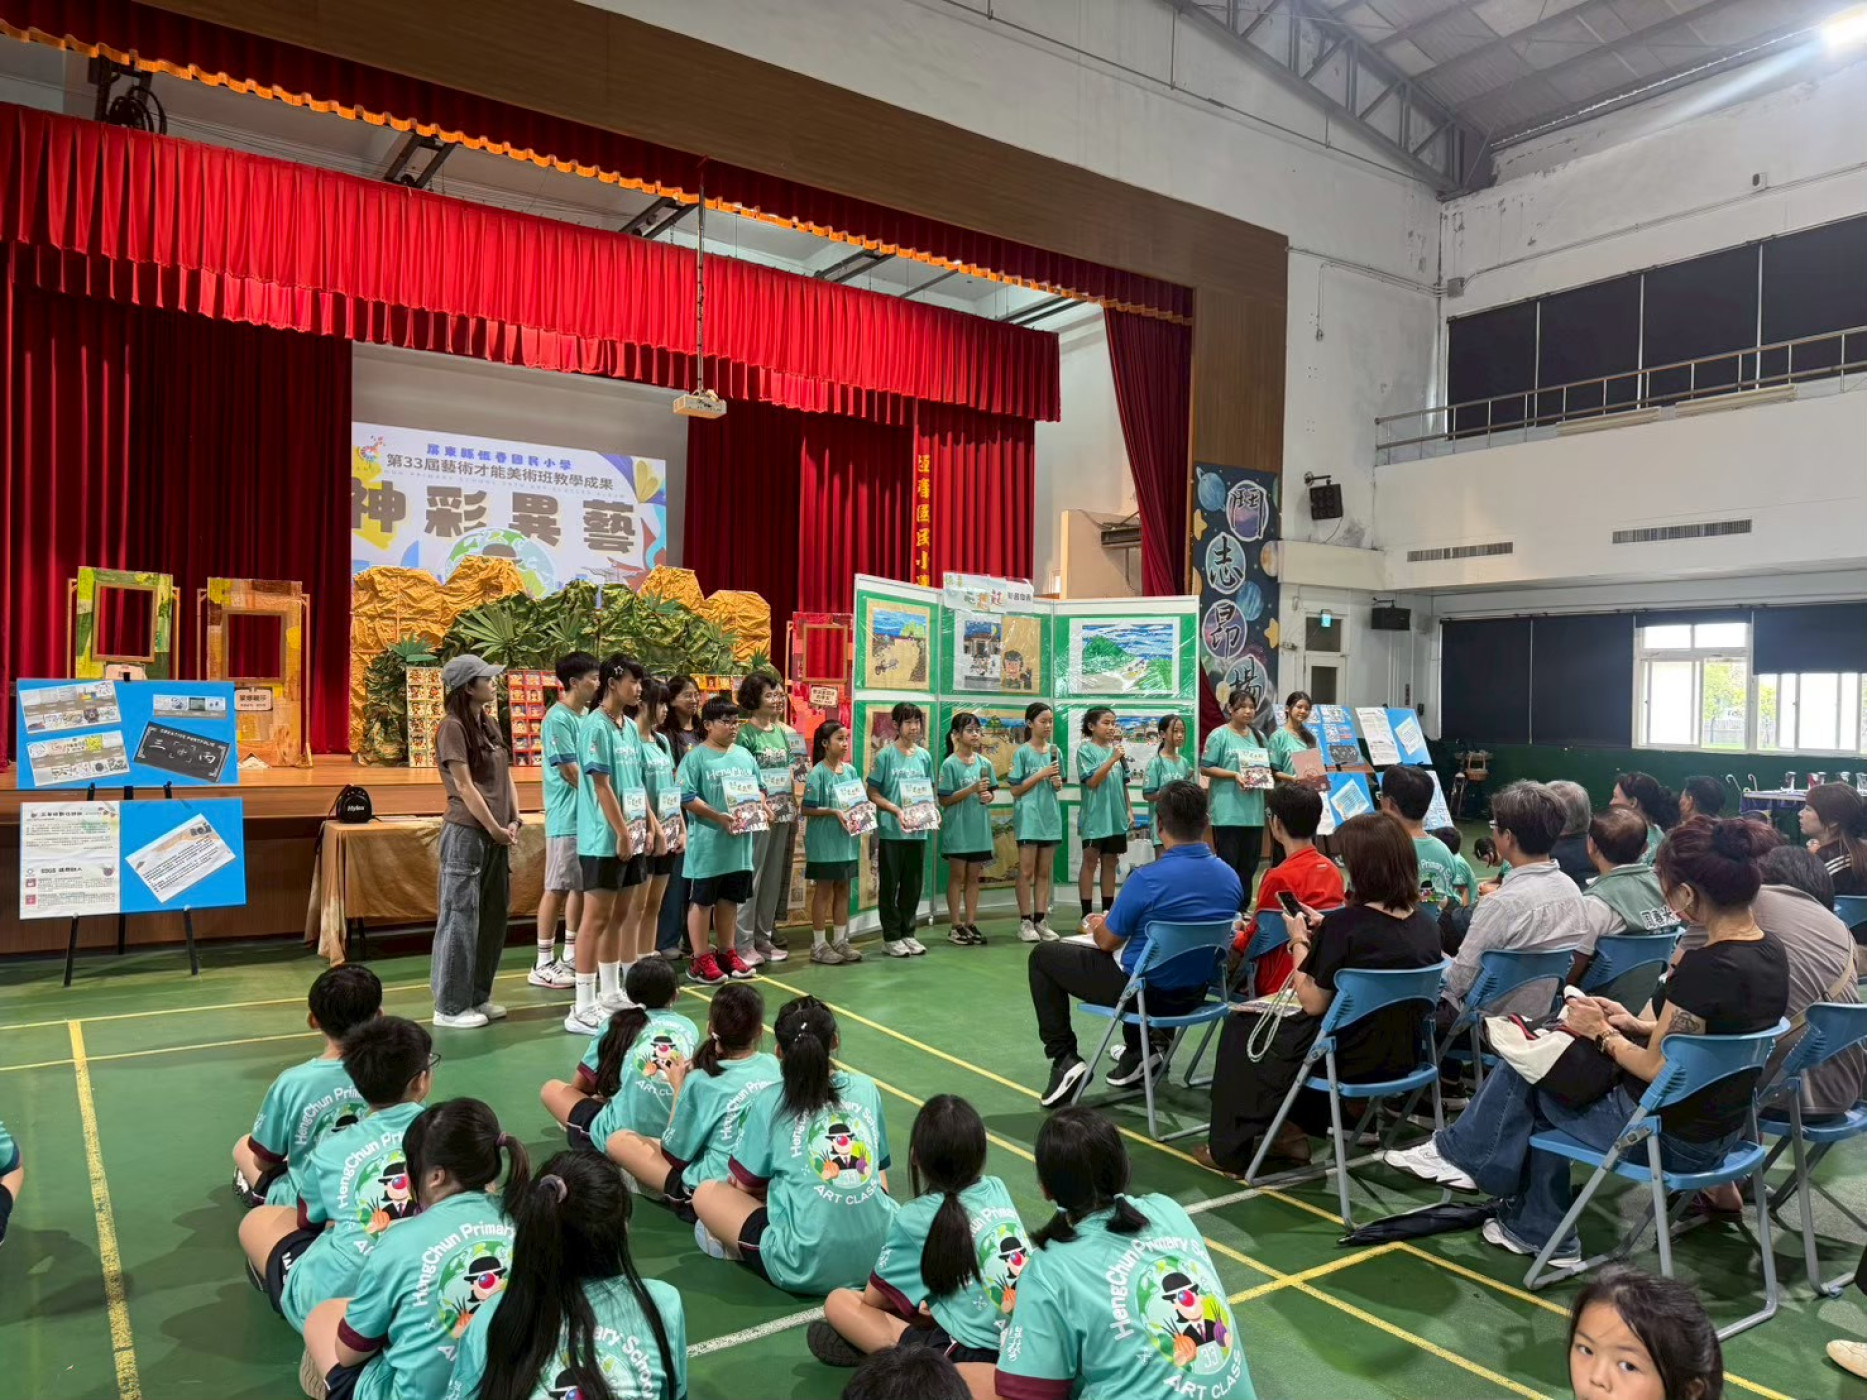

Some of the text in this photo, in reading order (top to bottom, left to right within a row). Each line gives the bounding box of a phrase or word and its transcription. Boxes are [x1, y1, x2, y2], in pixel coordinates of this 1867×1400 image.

[386, 453, 614, 490] 第33屆藝術才能美術班教學成果
[426, 442, 573, 471] 屏東縣恆春國民小學
[294, 1093, 333, 1145] HengChun
[337, 1139, 380, 1209] HengChun
[813, 1177, 879, 1205] ART CLASS
[1105, 1248, 1141, 1341] HengChun
[1162, 1349, 1243, 1399] ART CLASS
